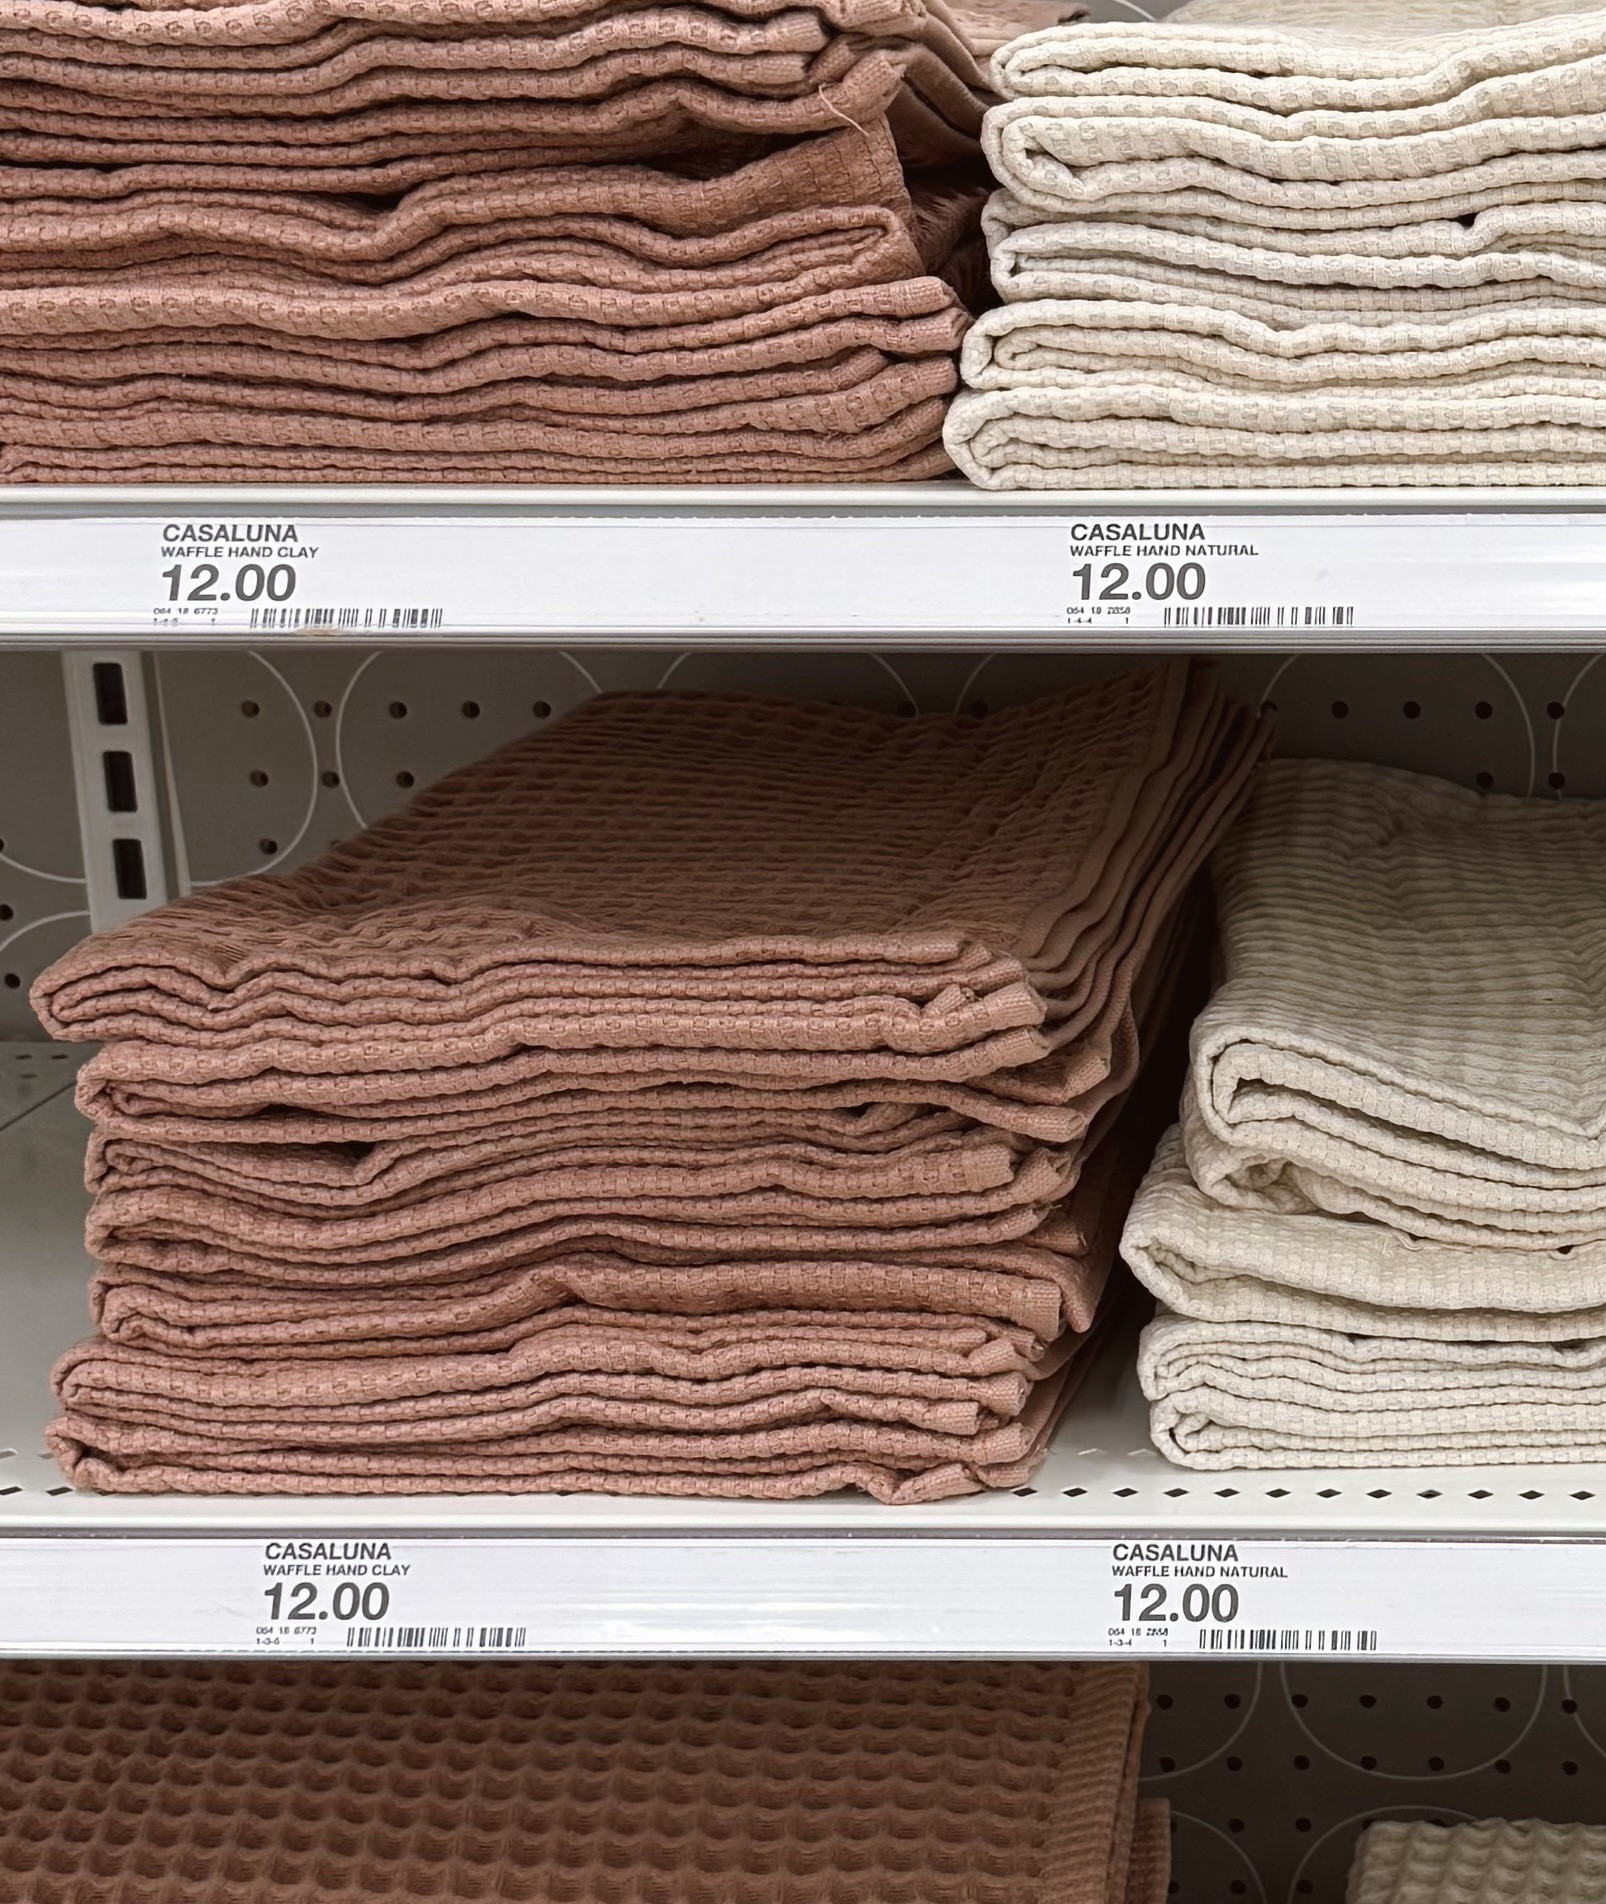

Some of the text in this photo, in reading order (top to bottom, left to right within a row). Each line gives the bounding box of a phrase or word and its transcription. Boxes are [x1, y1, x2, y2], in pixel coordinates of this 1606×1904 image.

[162, 524, 298, 543] CASALUNA
[1070, 523, 1206, 541] CASALUNA
[161, 546, 319, 558] WAFFLE HAND CLAY
[1070, 545, 1259, 557] WAFFLE HAND NATURAL
[162, 564, 296, 601] 12.00
[1072, 562, 1206, 601] 12.00
[265, 1542, 392, 1560] CASALUNA
[1113, 1543, 1239, 1562] CASALUNA
[263, 1564, 411, 1576] WAFFLE HAND CLAY
[1112, 1565, 1288, 1578] WAFFLE HAND NATURAL
[264, 1582, 390, 1620] 12.00
[1114, 1583, 1239, 1623] 12.00
